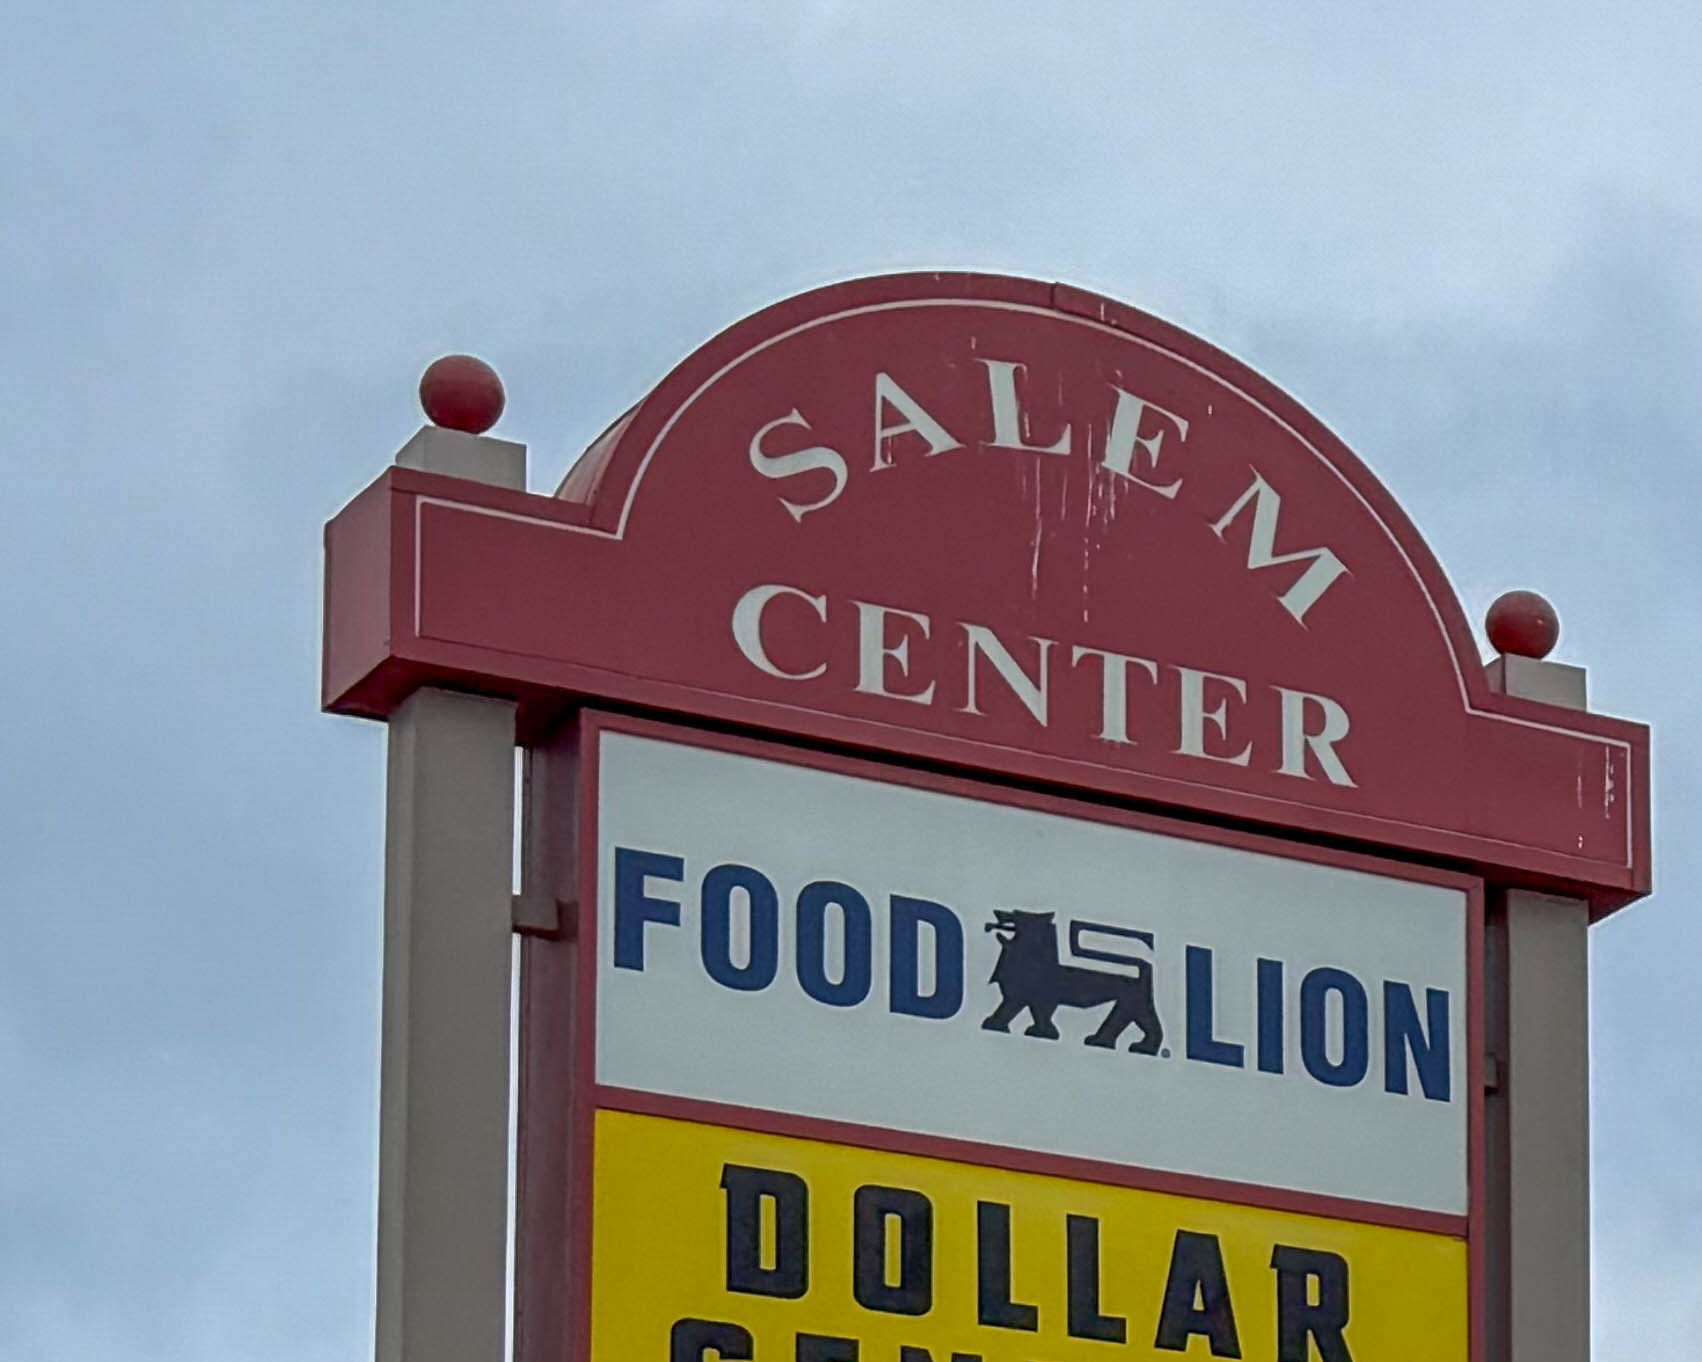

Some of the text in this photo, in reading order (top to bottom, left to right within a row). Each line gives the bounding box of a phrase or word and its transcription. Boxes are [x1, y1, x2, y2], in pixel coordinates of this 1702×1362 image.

[748, 357, 1353, 629] SALEM
[732, 584, 1359, 789] CENTER
[613, 846, 1452, 1103] FOOD LION
